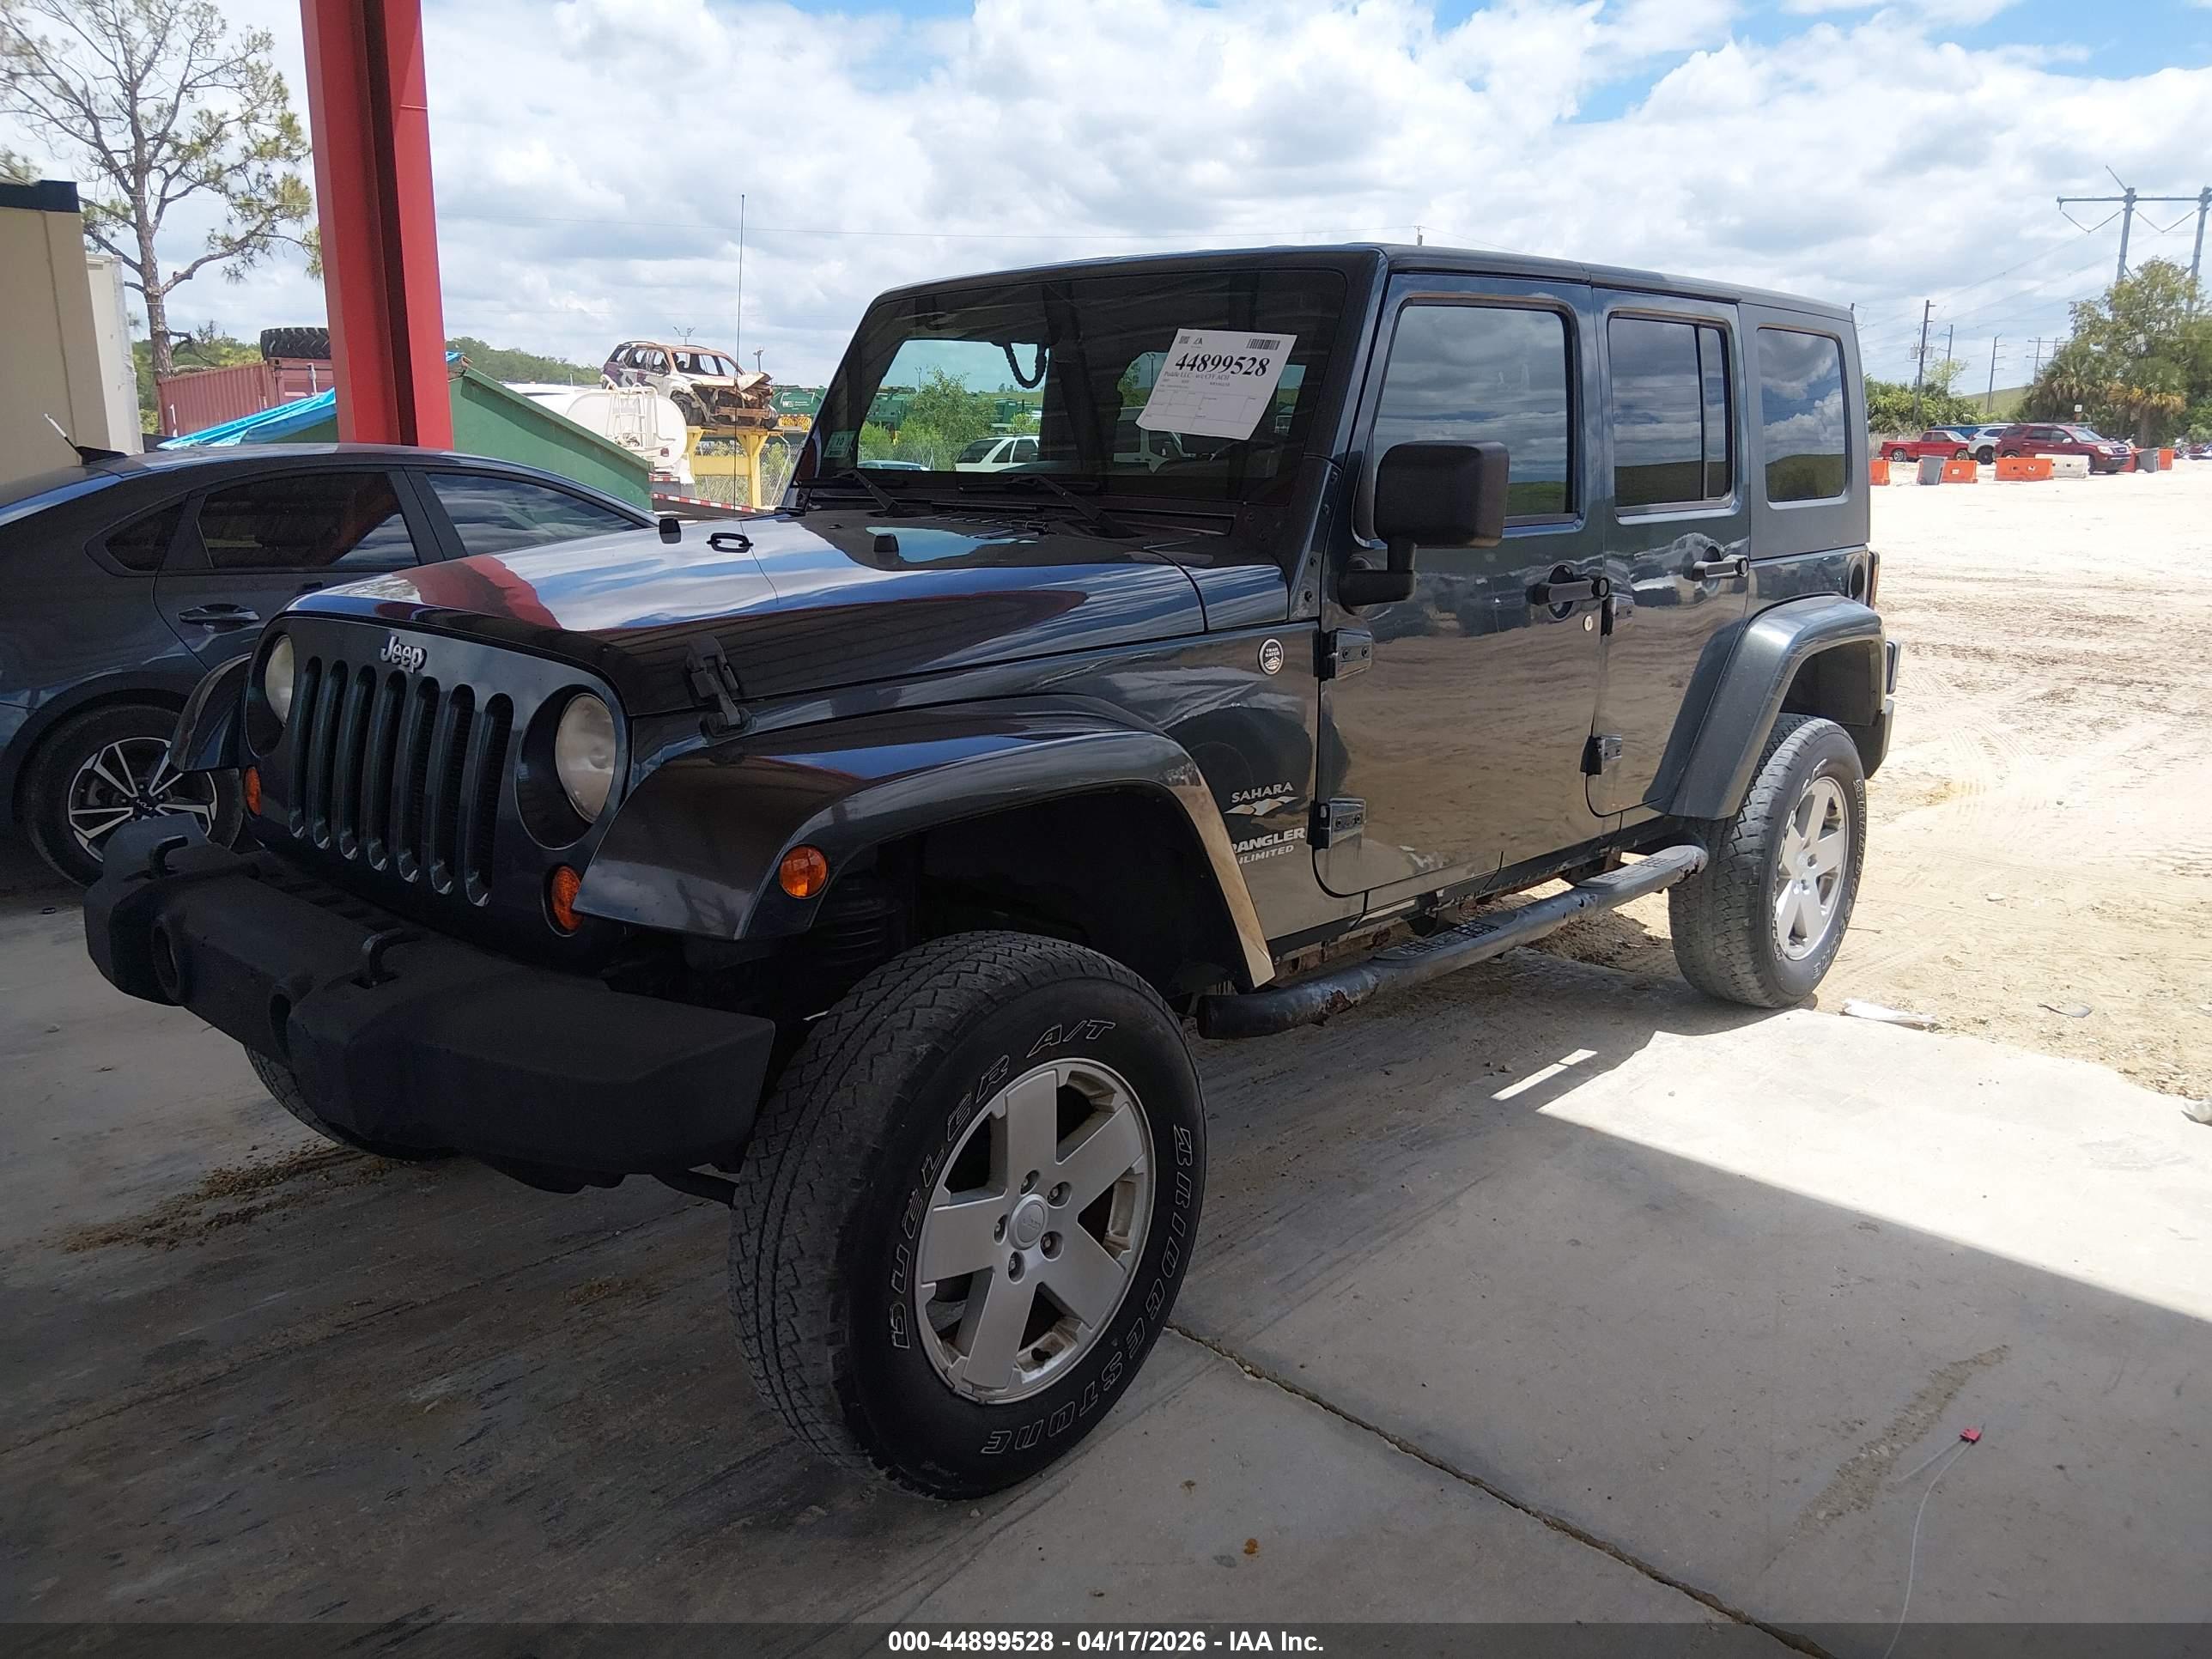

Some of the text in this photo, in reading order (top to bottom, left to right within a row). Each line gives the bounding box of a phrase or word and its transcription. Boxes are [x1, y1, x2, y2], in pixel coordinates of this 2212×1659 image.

[1175, 352, 1271, 377] 44899528
[380, 635, 426, 674] Jeep
[1231, 781, 1294, 804] SAHARA
[1231, 827, 1306, 854] RANGLER
[1238, 844, 1295, 865] NLIMITED
[890, 1054, 1011, 1349] DUELER
[980, 1124, 1195, 1455] BRIDGESTONE
